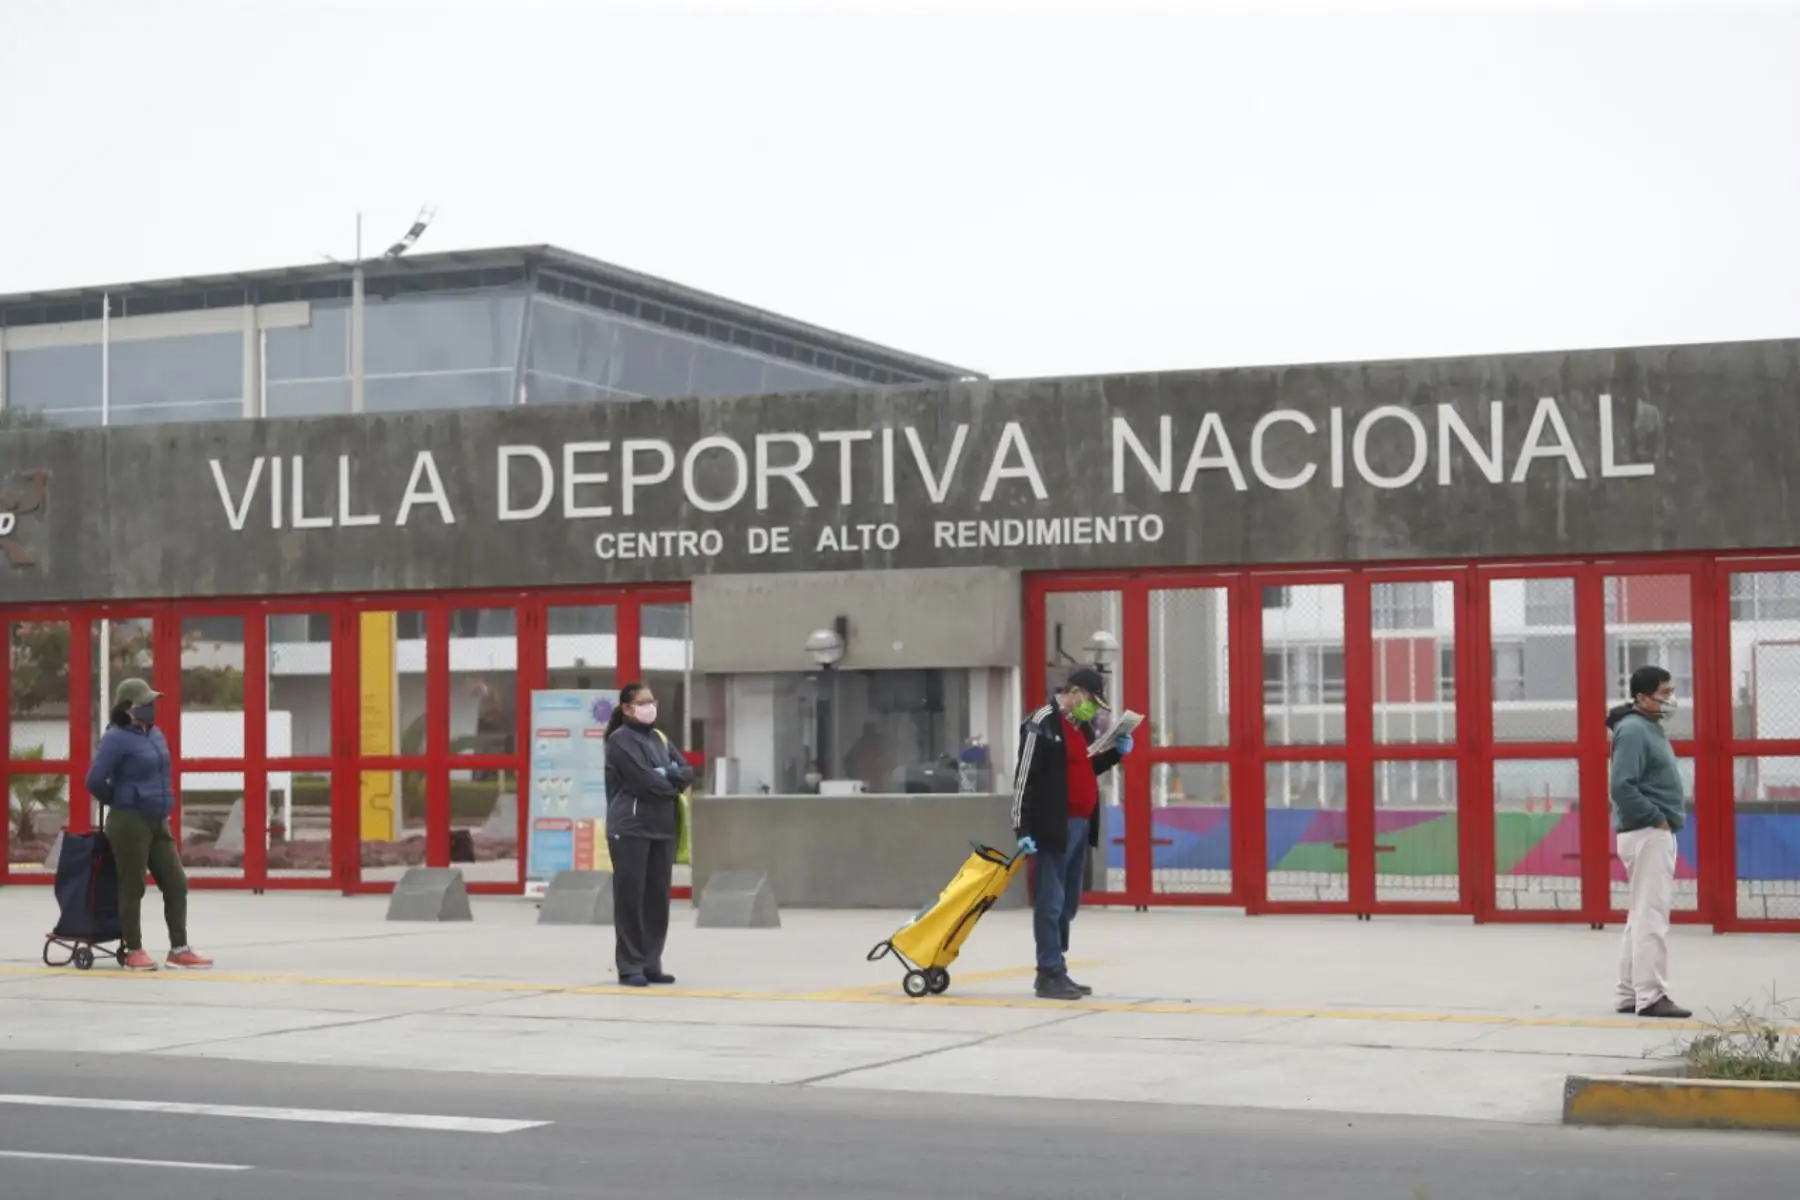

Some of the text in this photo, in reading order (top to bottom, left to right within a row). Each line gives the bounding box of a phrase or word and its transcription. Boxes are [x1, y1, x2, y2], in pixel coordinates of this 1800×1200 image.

[209, 393, 1655, 532] VILLA DEPORTIVA NACIONAL
[595, 513, 1165, 559] CENTRO DE ALTO RENDIMIENTO
